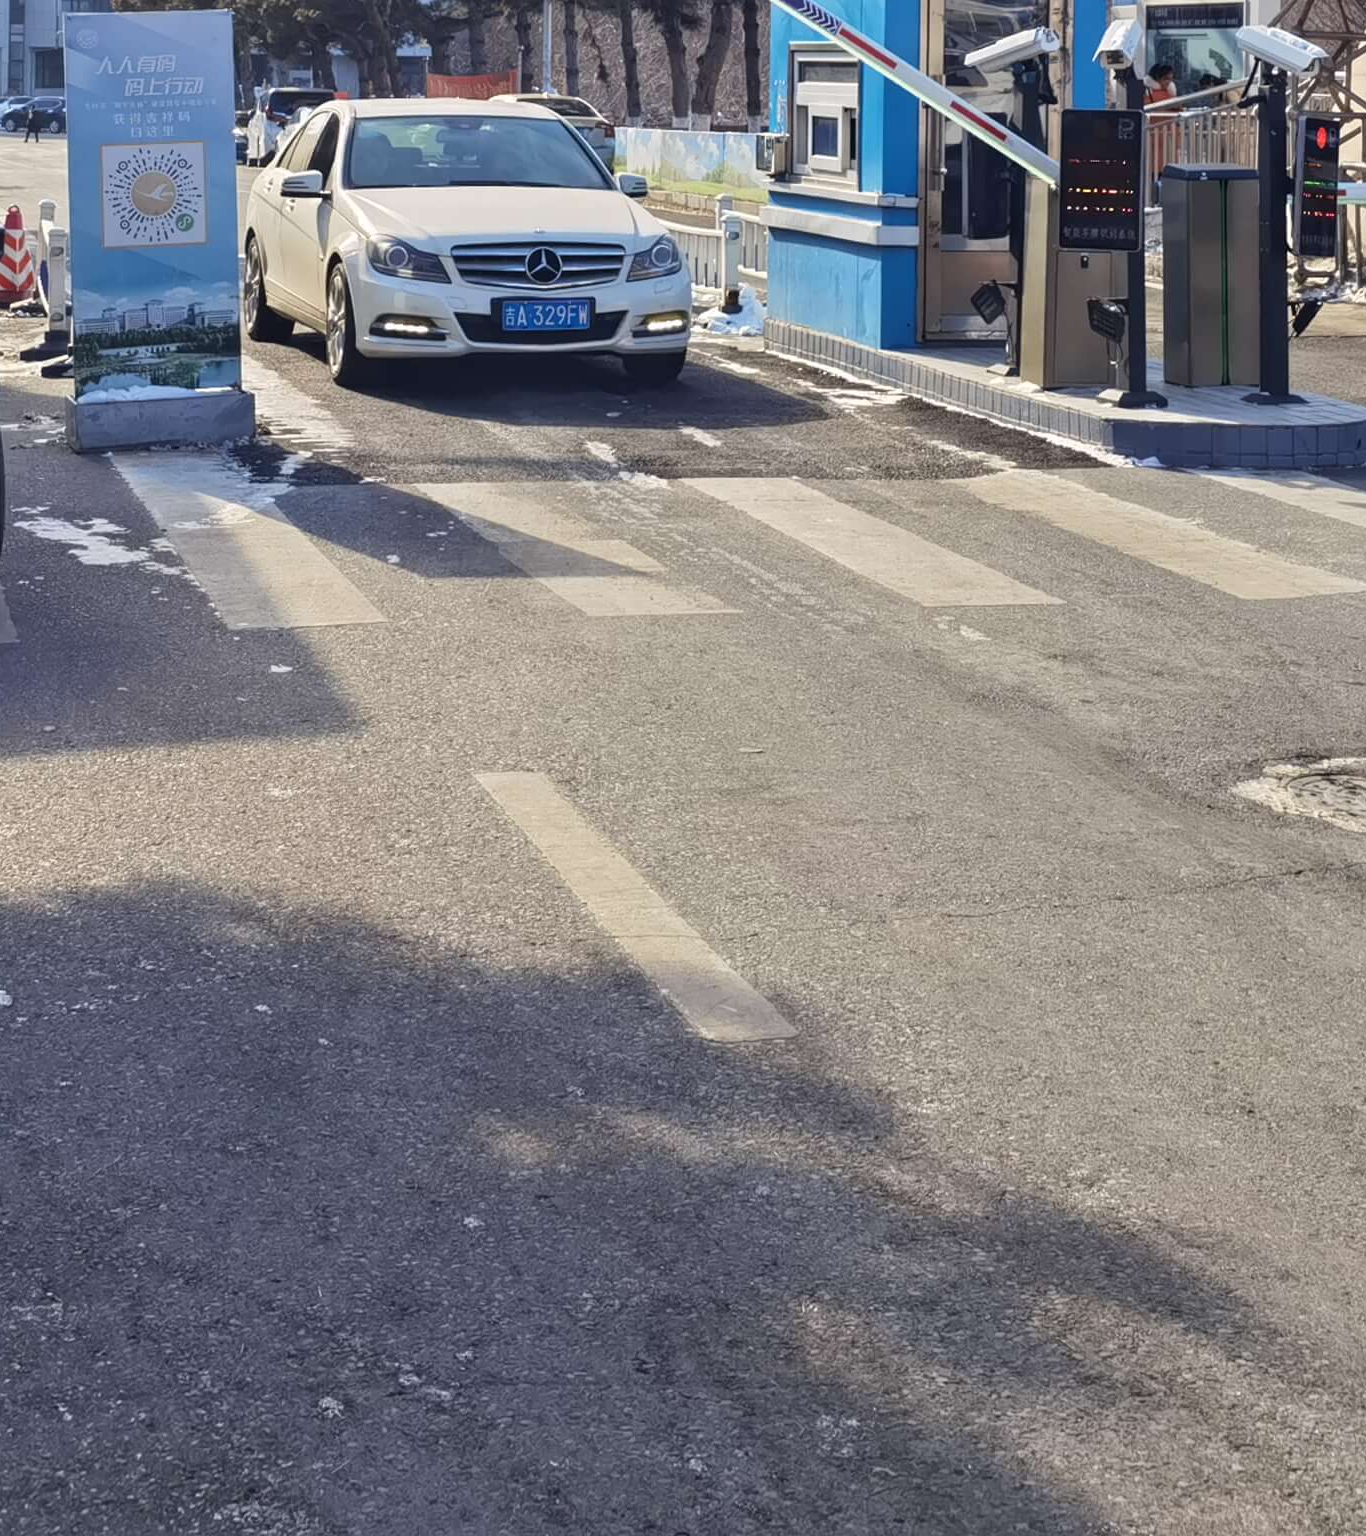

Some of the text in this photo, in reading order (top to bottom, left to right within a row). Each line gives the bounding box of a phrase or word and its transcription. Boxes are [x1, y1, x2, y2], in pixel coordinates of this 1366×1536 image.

[96, 54, 177, 75] 人人有码
[124, 76, 204, 97] 码上行动
